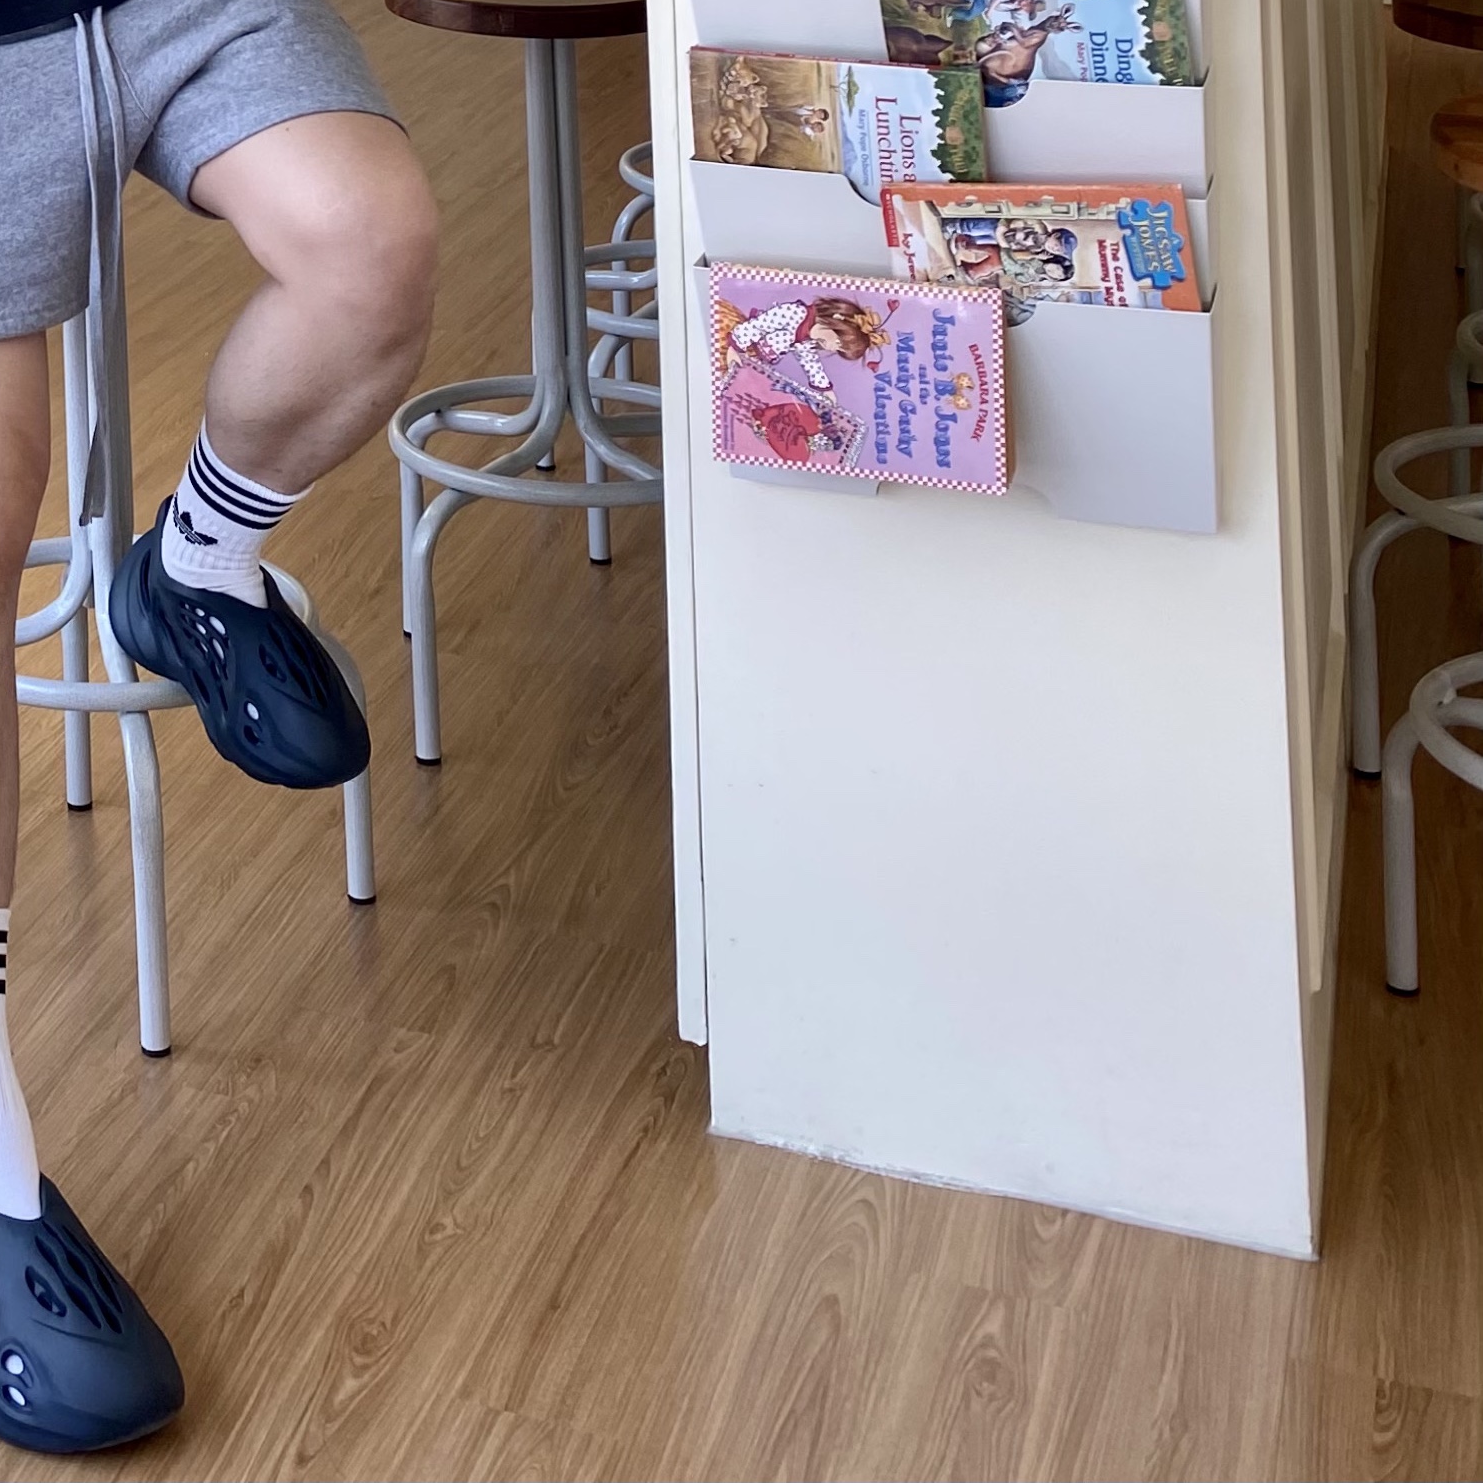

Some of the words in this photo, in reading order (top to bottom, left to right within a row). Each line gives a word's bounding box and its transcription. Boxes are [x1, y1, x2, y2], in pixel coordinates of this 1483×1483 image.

[1077, 42, 1086, 65] Mary
[857, 109, 867, 130] Mary
[859, 132, 868, 152] Pope
[899, 114, 922, 169] Lions
[902, 233, 914, 249] by
[1110, 241, 1121, 262] The
[1128, 217, 1161, 272] JONES
[1097, 239, 1111, 283] Mummy
[1114, 266, 1125, 293] Case
[931, 308, 956, 372] Junie
[894, 330, 915, 397] Mushy
[969, 343, 989, 406] BARBARA
[934, 377, 957, 401] B.
[895, 400, 918, 458] Gushy
[934, 405, 958, 468] Jones
[971, 408, 989, 442] PARK
